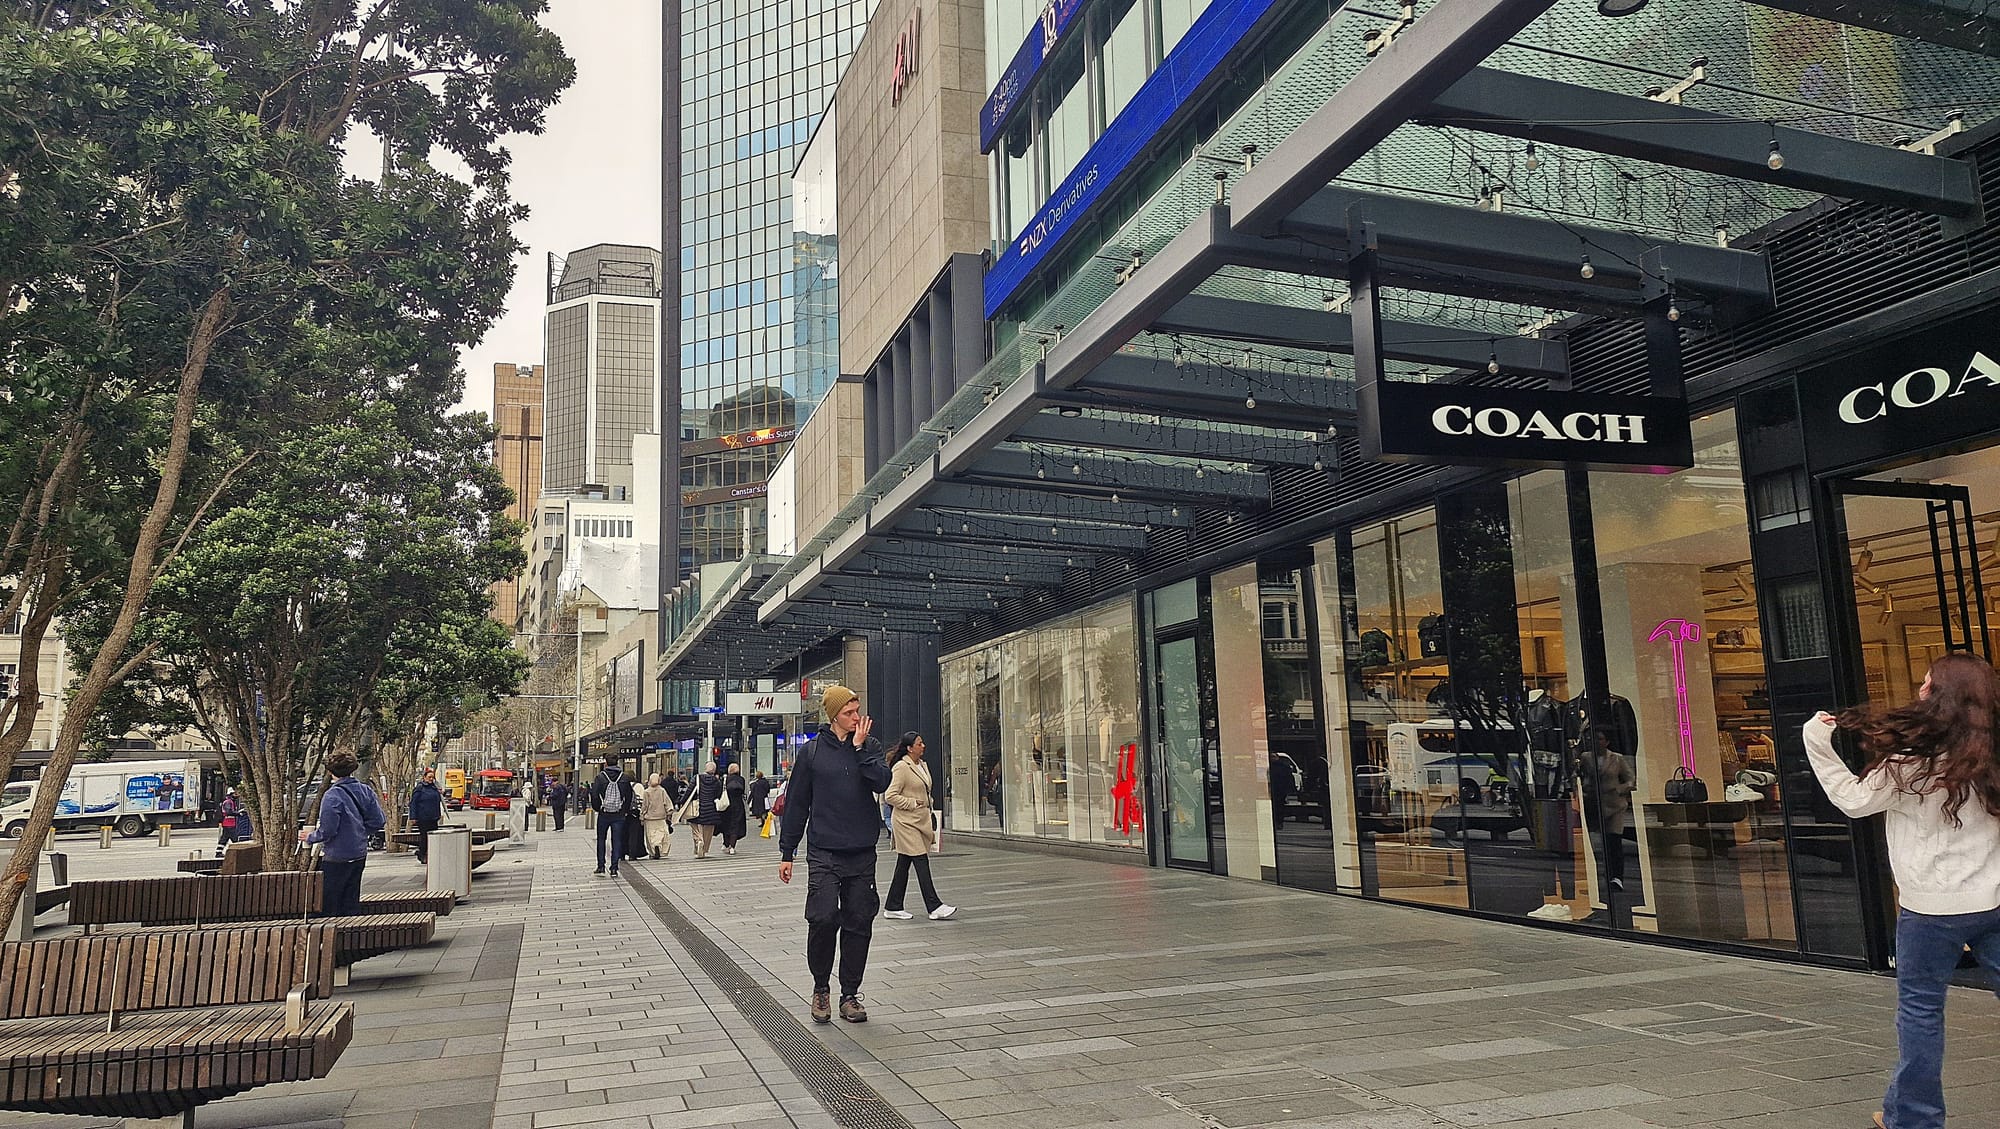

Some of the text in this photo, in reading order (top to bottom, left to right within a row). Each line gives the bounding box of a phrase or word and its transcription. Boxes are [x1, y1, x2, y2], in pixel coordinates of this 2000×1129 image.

[1042, 7, 1056, 44] 10
[1029, 164, 1099, 253] NZX Derivatives
[746, 432, 775, 444] Congrats
[1431, 405, 1648, 444] COACH
[754, 696, 775, 710] H&M
